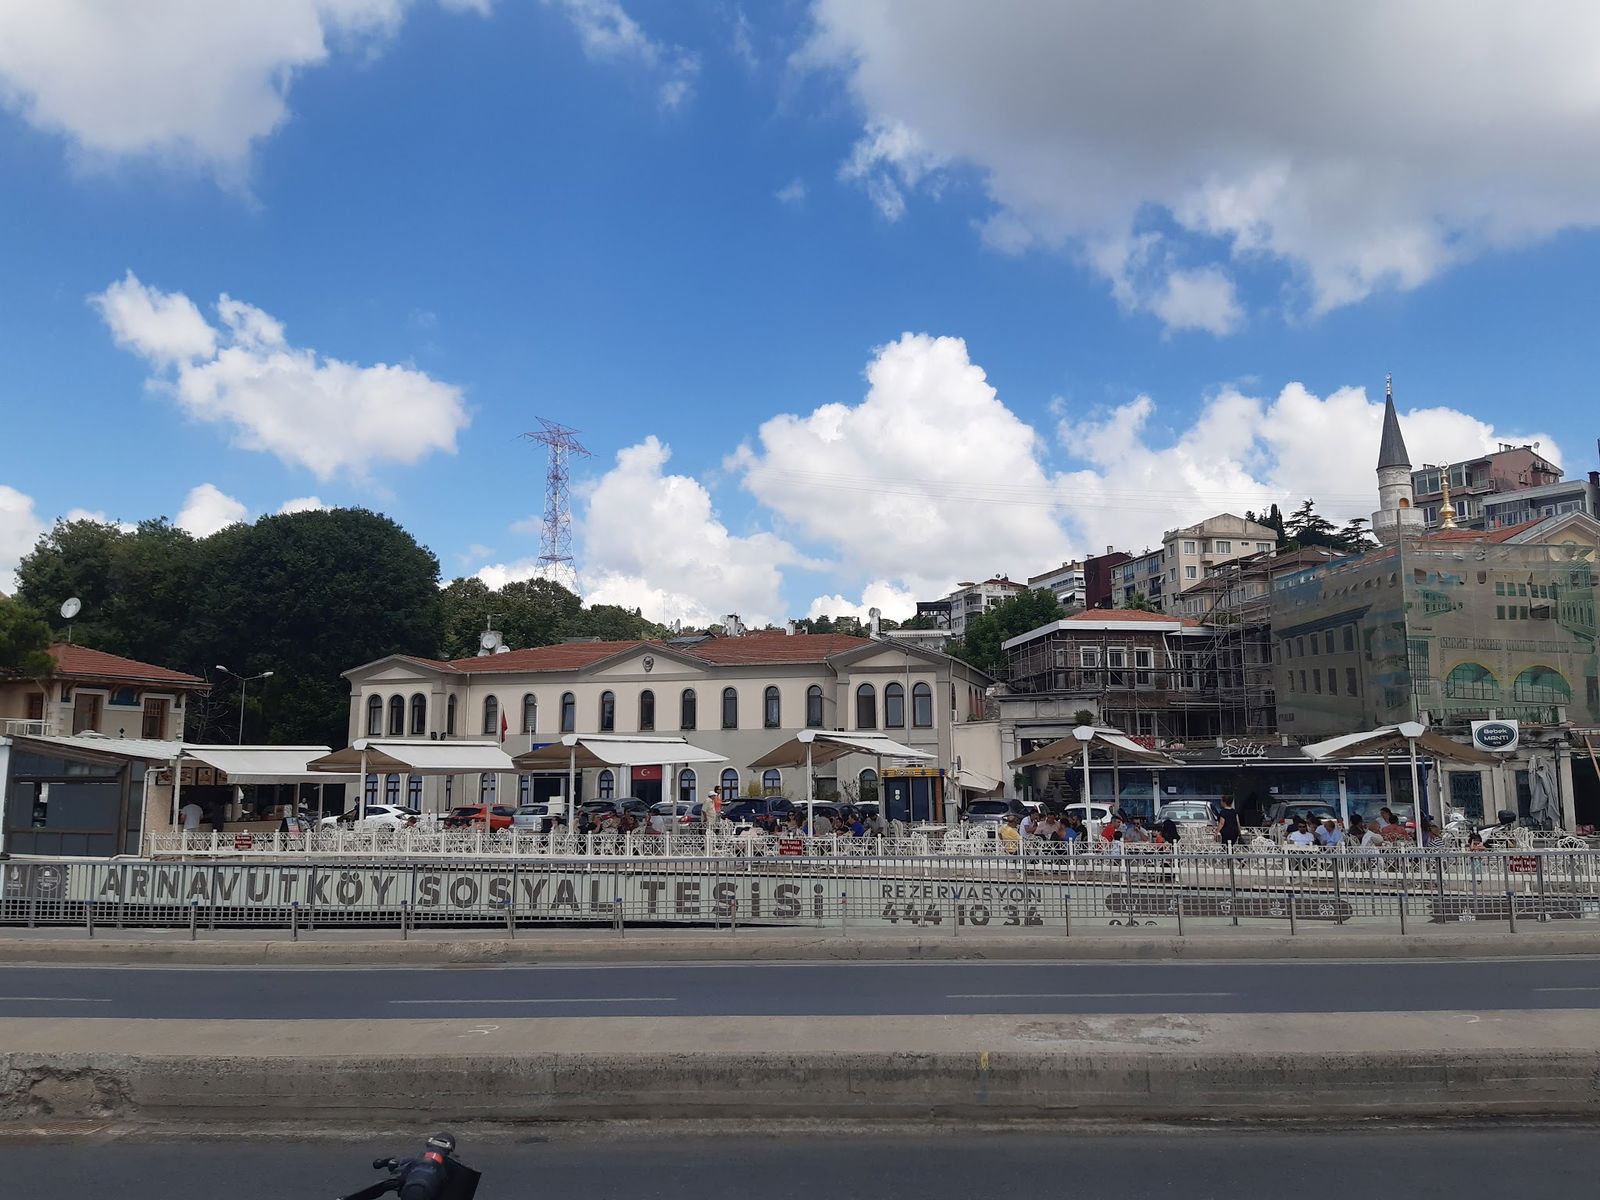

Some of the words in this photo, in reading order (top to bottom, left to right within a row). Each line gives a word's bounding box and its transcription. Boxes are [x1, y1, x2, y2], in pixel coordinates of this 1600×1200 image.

[100, 868, 395, 906] ARNAVUTKÖY
[417, 876, 613, 912] SOSYAL
[882, 884, 1042, 903] REZERVASYON
[882, 902, 942, 926] 444
